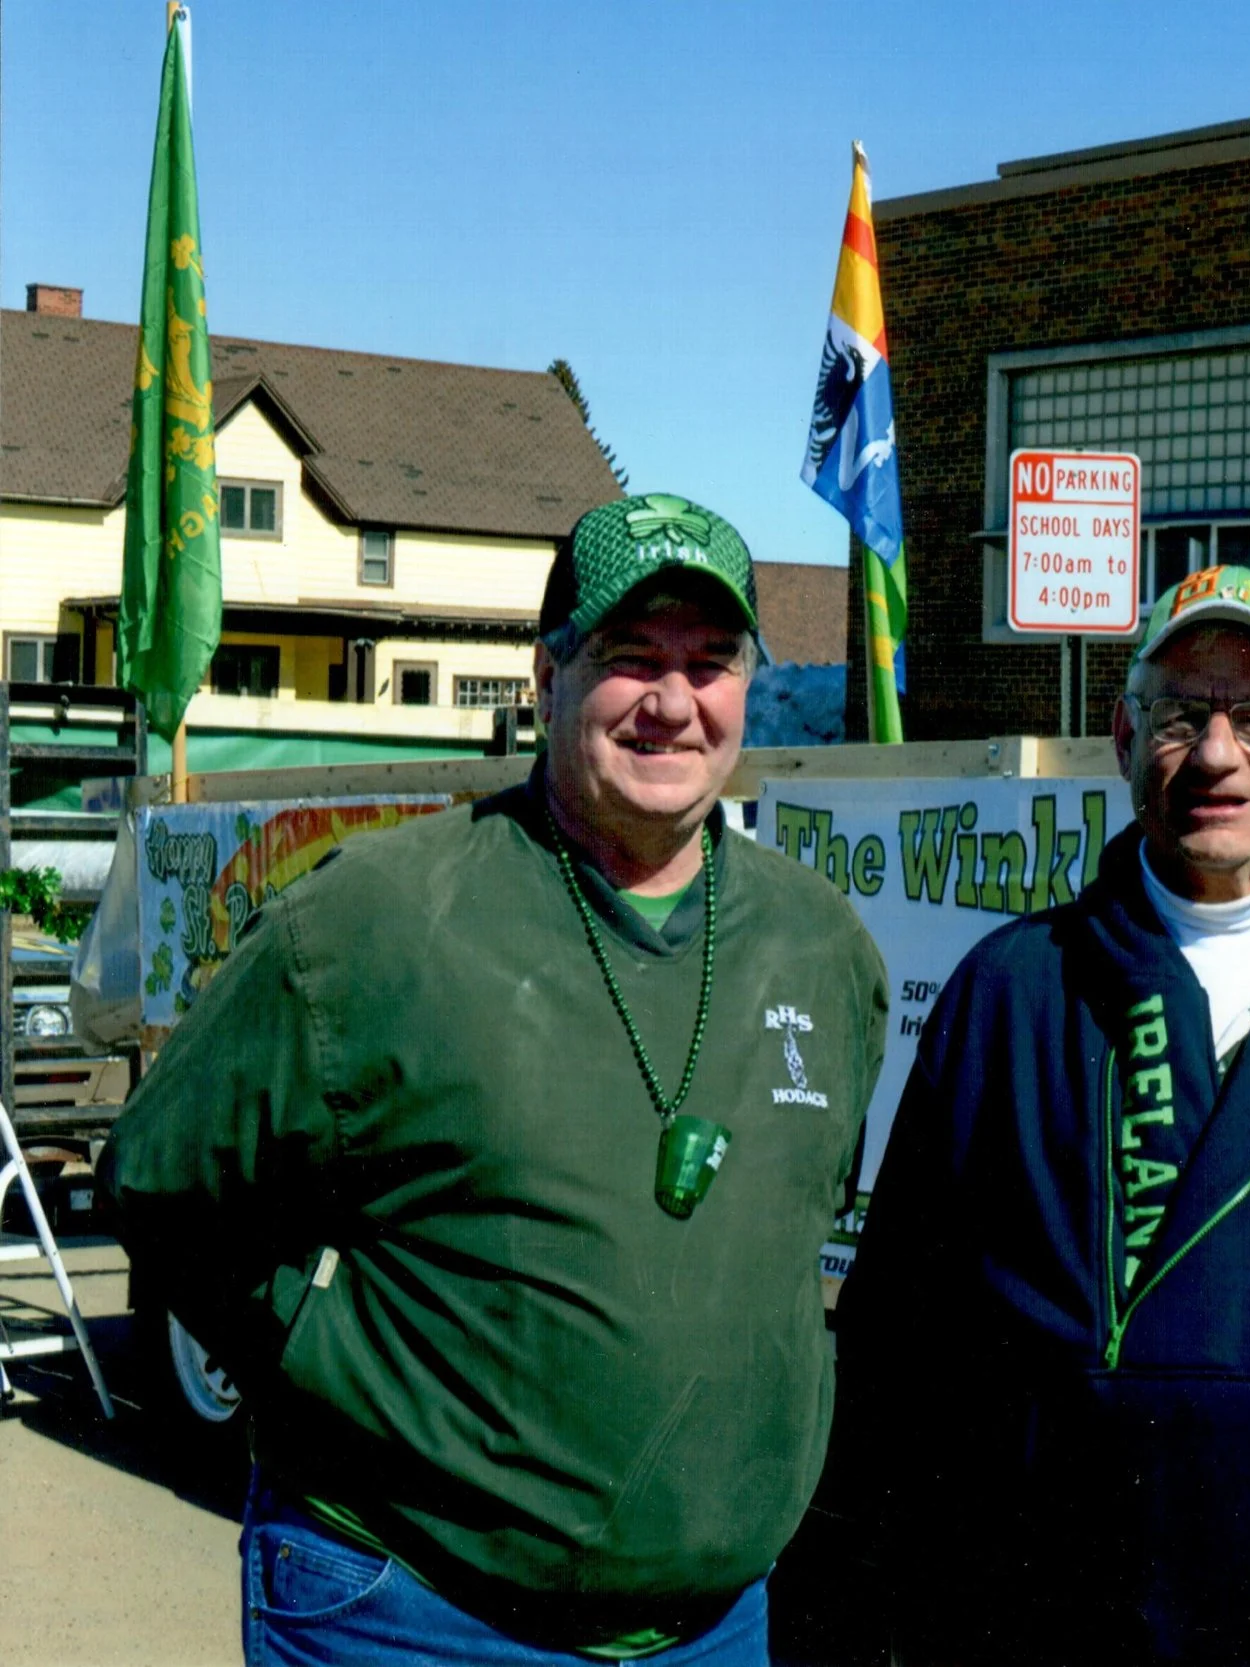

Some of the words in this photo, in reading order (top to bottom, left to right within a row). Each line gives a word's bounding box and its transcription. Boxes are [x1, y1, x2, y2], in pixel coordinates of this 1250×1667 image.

[1018, 462, 1049, 495] NO
[1056, 469, 1132, 492] PARKING
[1020, 515, 1080, 537] SCHOOL
[1092, 518, 1130, 537] DAYS
[637, 540, 708, 563] irish
[1023, 552, 1092, 574] 7:00am
[1108, 555, 1127, 574] to
[1039, 586, 1110, 609] 4:00pm
[145, 817, 217, 884] Happy
[776, 800, 886, 896] The
[899, 790, 1106, 914] Winkl
[181, 882, 217, 955] St.
[765, 1005, 813, 1032] RHS
[900, 1015, 923, 1036] Iri
[1122, 995, 1178, 1288] IRELAN
